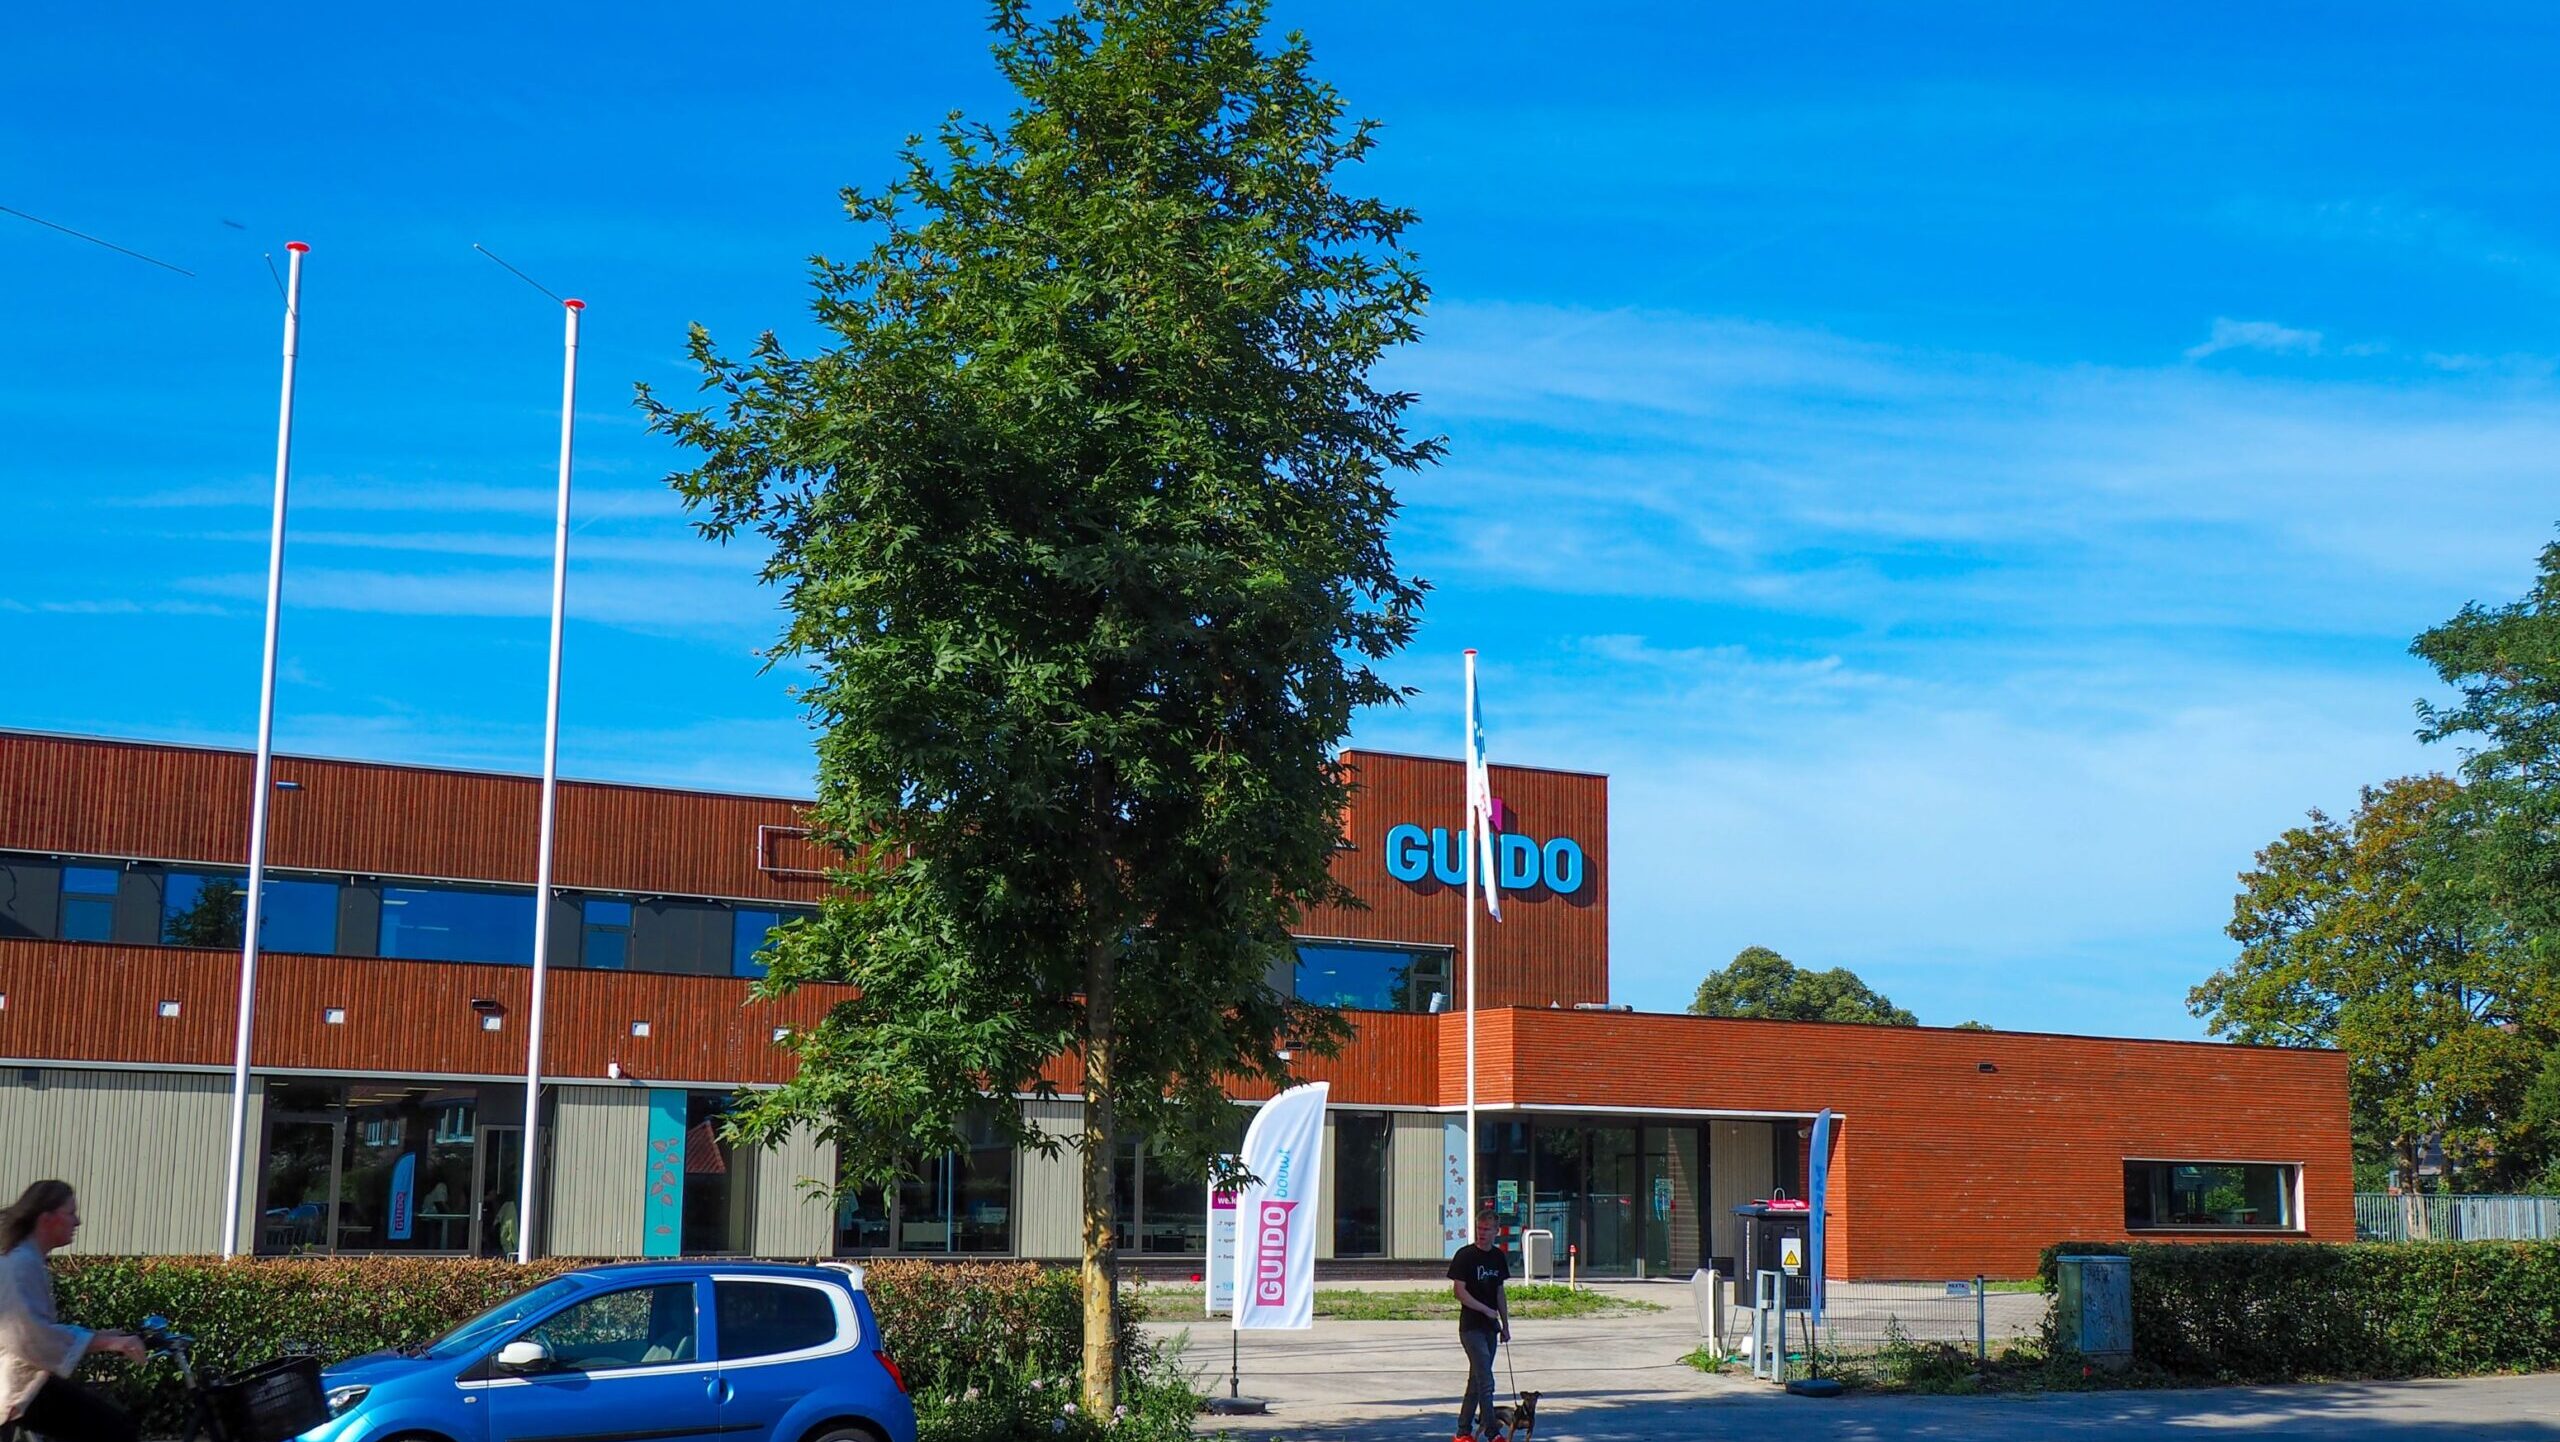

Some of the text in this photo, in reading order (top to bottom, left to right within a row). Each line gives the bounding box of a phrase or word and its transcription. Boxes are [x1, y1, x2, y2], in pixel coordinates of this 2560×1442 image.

[1386, 824, 1583, 893] GUDO
[1274, 1149, 1291, 1198] bouwt
[1260, 1206, 1286, 1300] GUIDO
